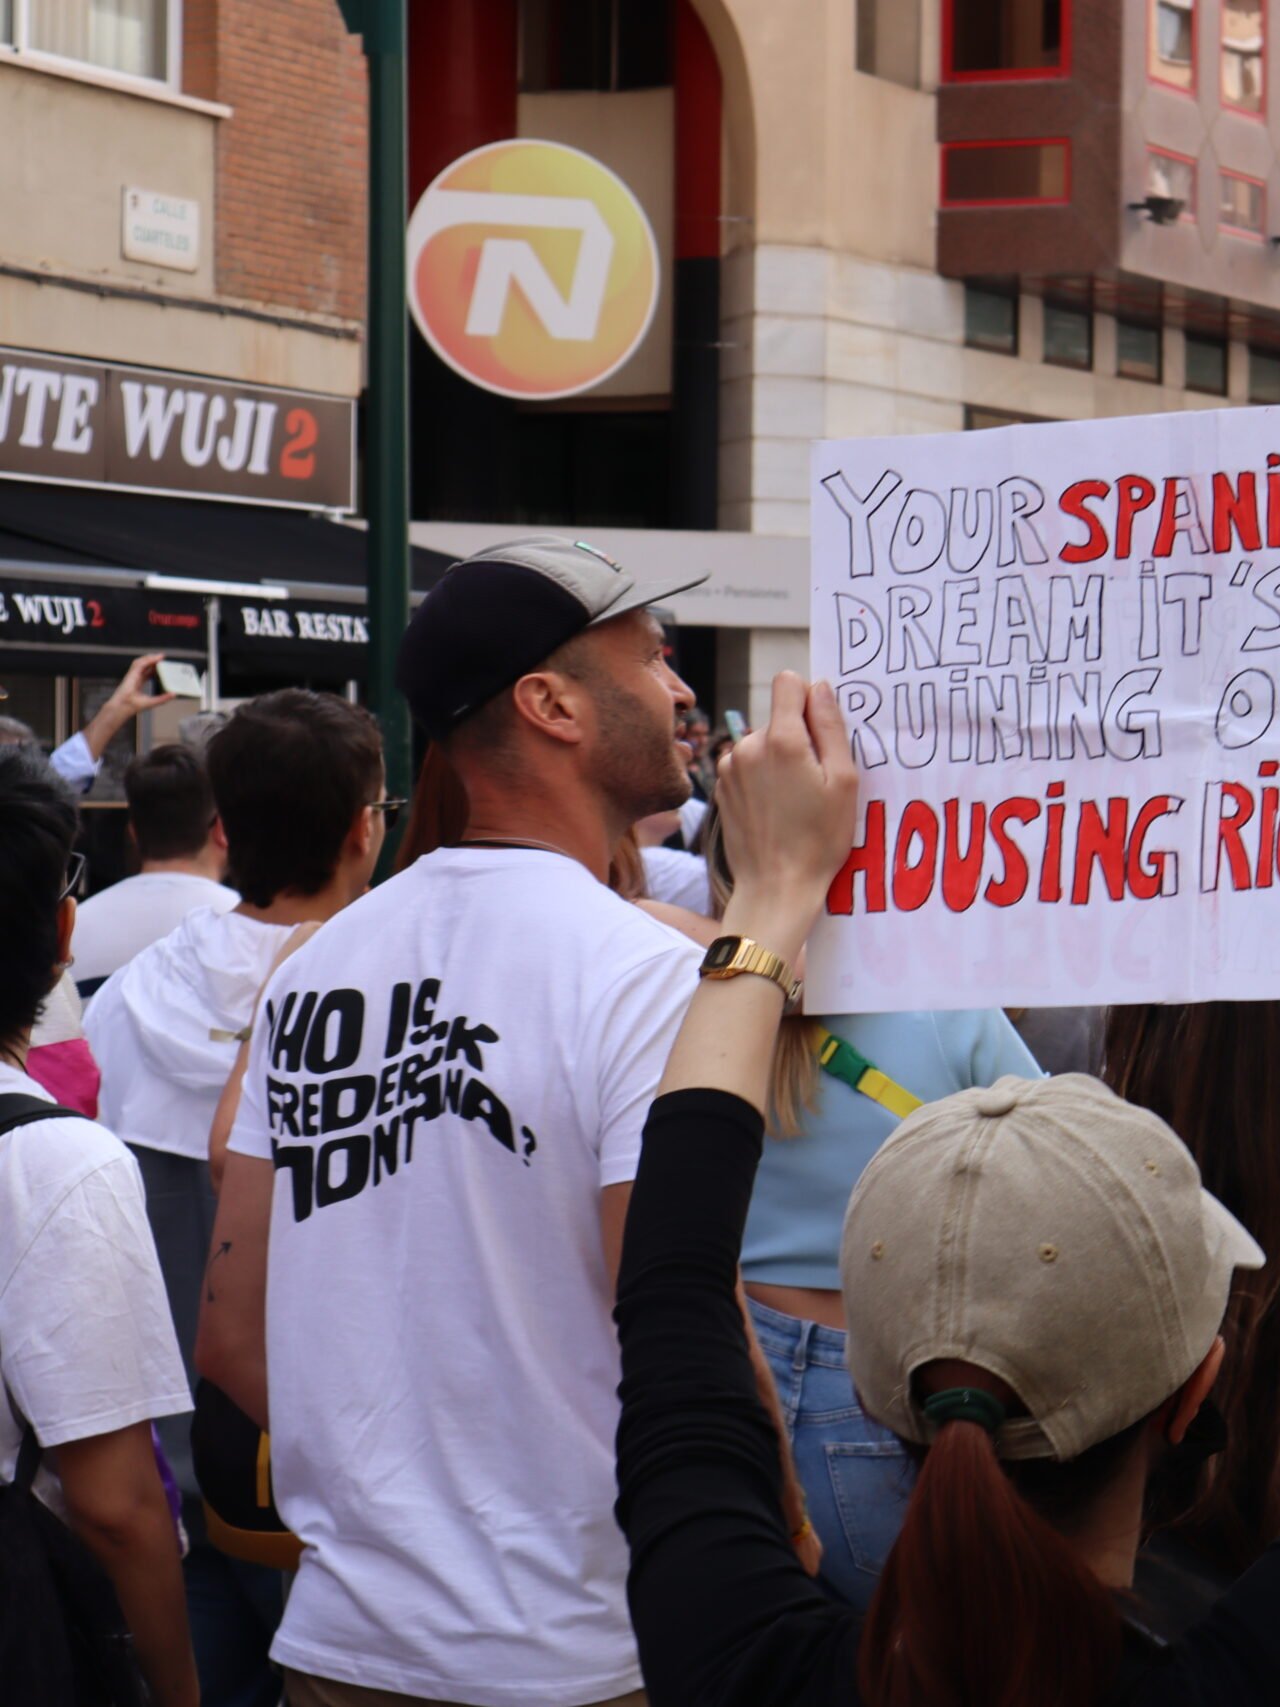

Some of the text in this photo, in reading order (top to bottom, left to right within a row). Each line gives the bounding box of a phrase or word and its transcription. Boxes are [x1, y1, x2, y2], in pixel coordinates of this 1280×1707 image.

[821, 469, 1050, 578] YOUR
[241, 606, 370, 643] BAR RESTA
[832, 574, 1105, 675] DREAM
